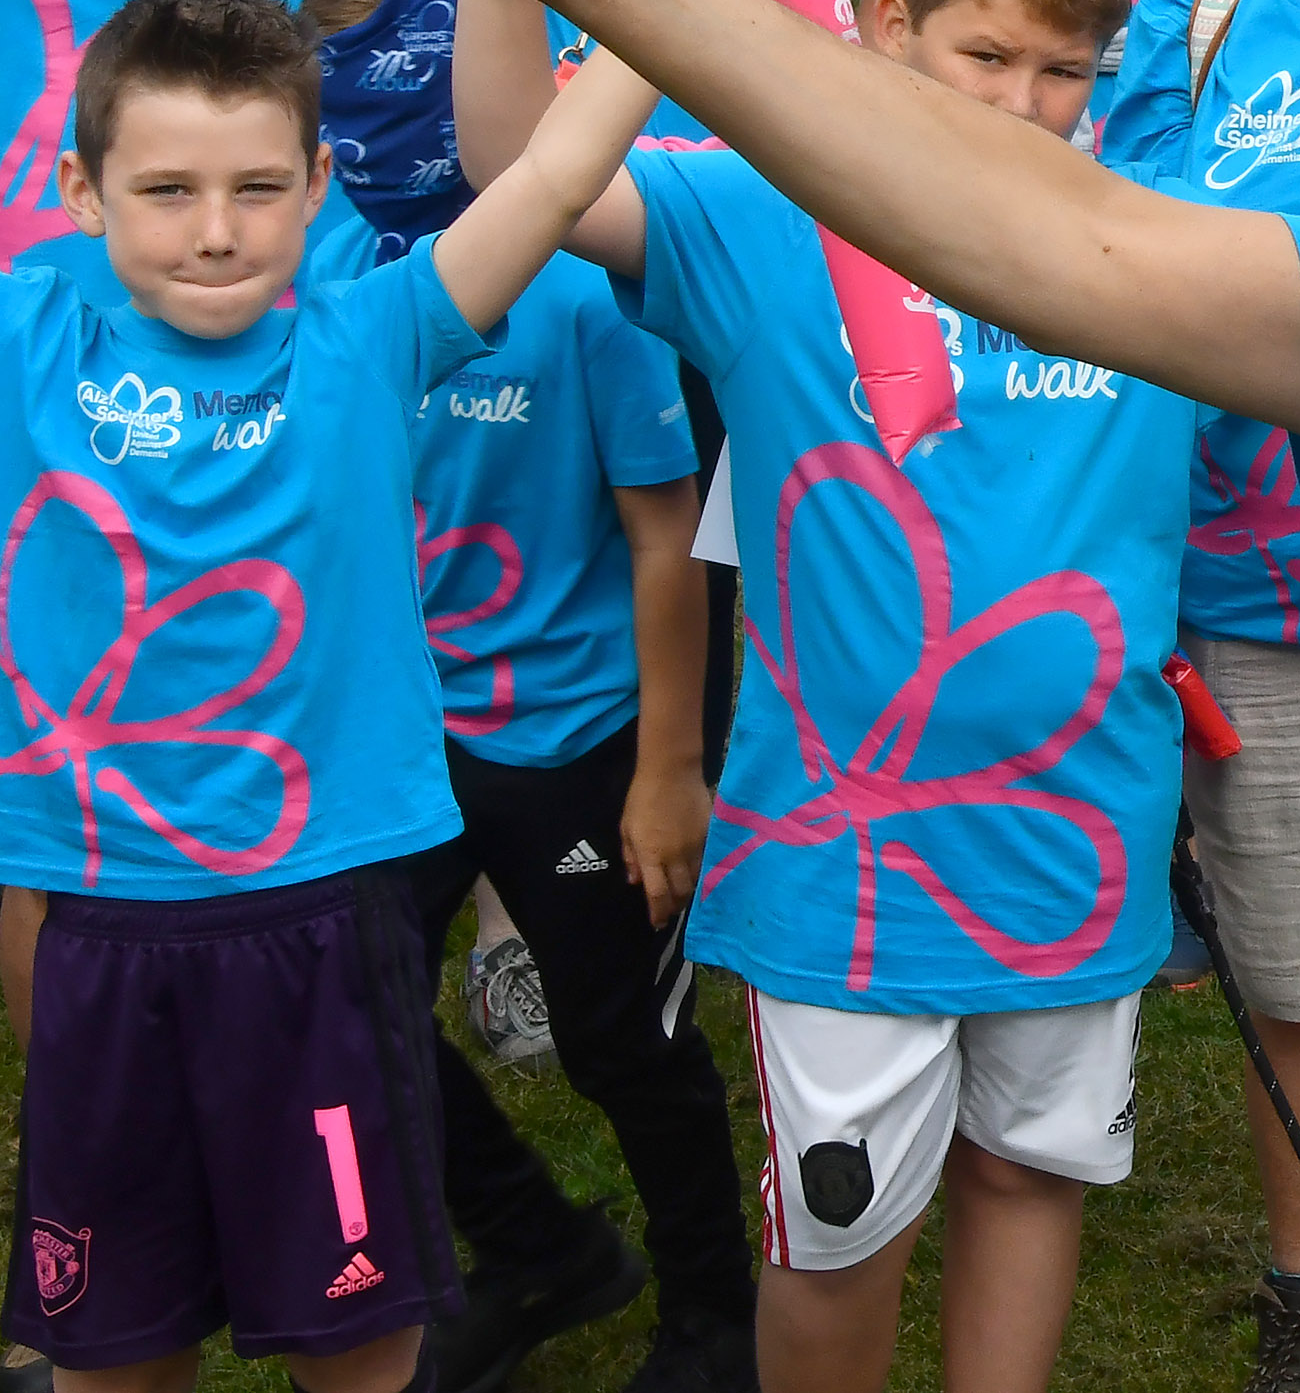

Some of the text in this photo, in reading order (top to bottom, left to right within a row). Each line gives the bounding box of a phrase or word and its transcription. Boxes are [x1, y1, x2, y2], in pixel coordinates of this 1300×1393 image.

[1006, 361, 1118, 400] walk
[450, 385, 530, 423] walk
[555, 859, 609, 874] adidas
[314, 1104, 369, 1244] 1
[325, 1271, 385, 1299] adidas
